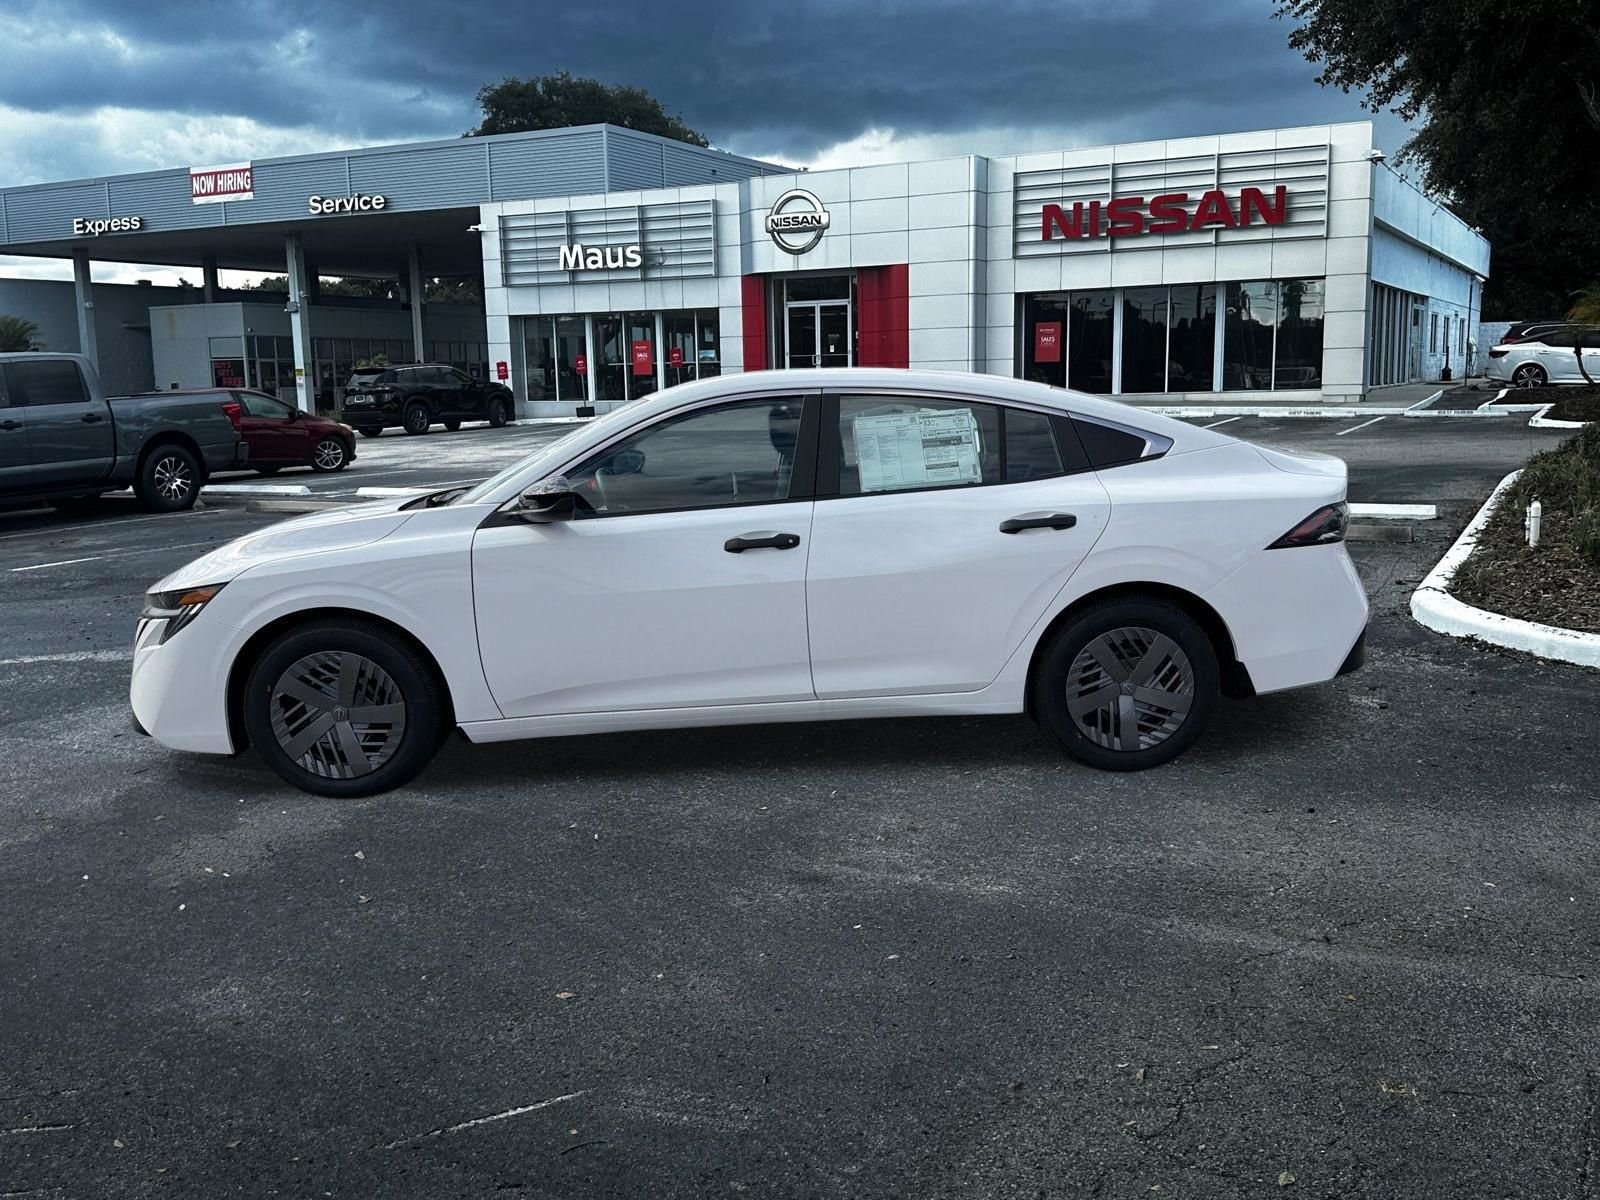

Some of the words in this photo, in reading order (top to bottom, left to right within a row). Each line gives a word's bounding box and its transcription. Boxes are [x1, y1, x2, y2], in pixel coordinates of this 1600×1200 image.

[192, 175, 216, 195] NOW
[217, 171, 251, 193] HIRING
[308, 192, 386, 215] Service
[1041, 184, 1288, 242] NISSAN
[72, 215, 142, 237] Express
[770, 215, 822, 229] NISSAN
[558, 243, 642, 271] Maus
